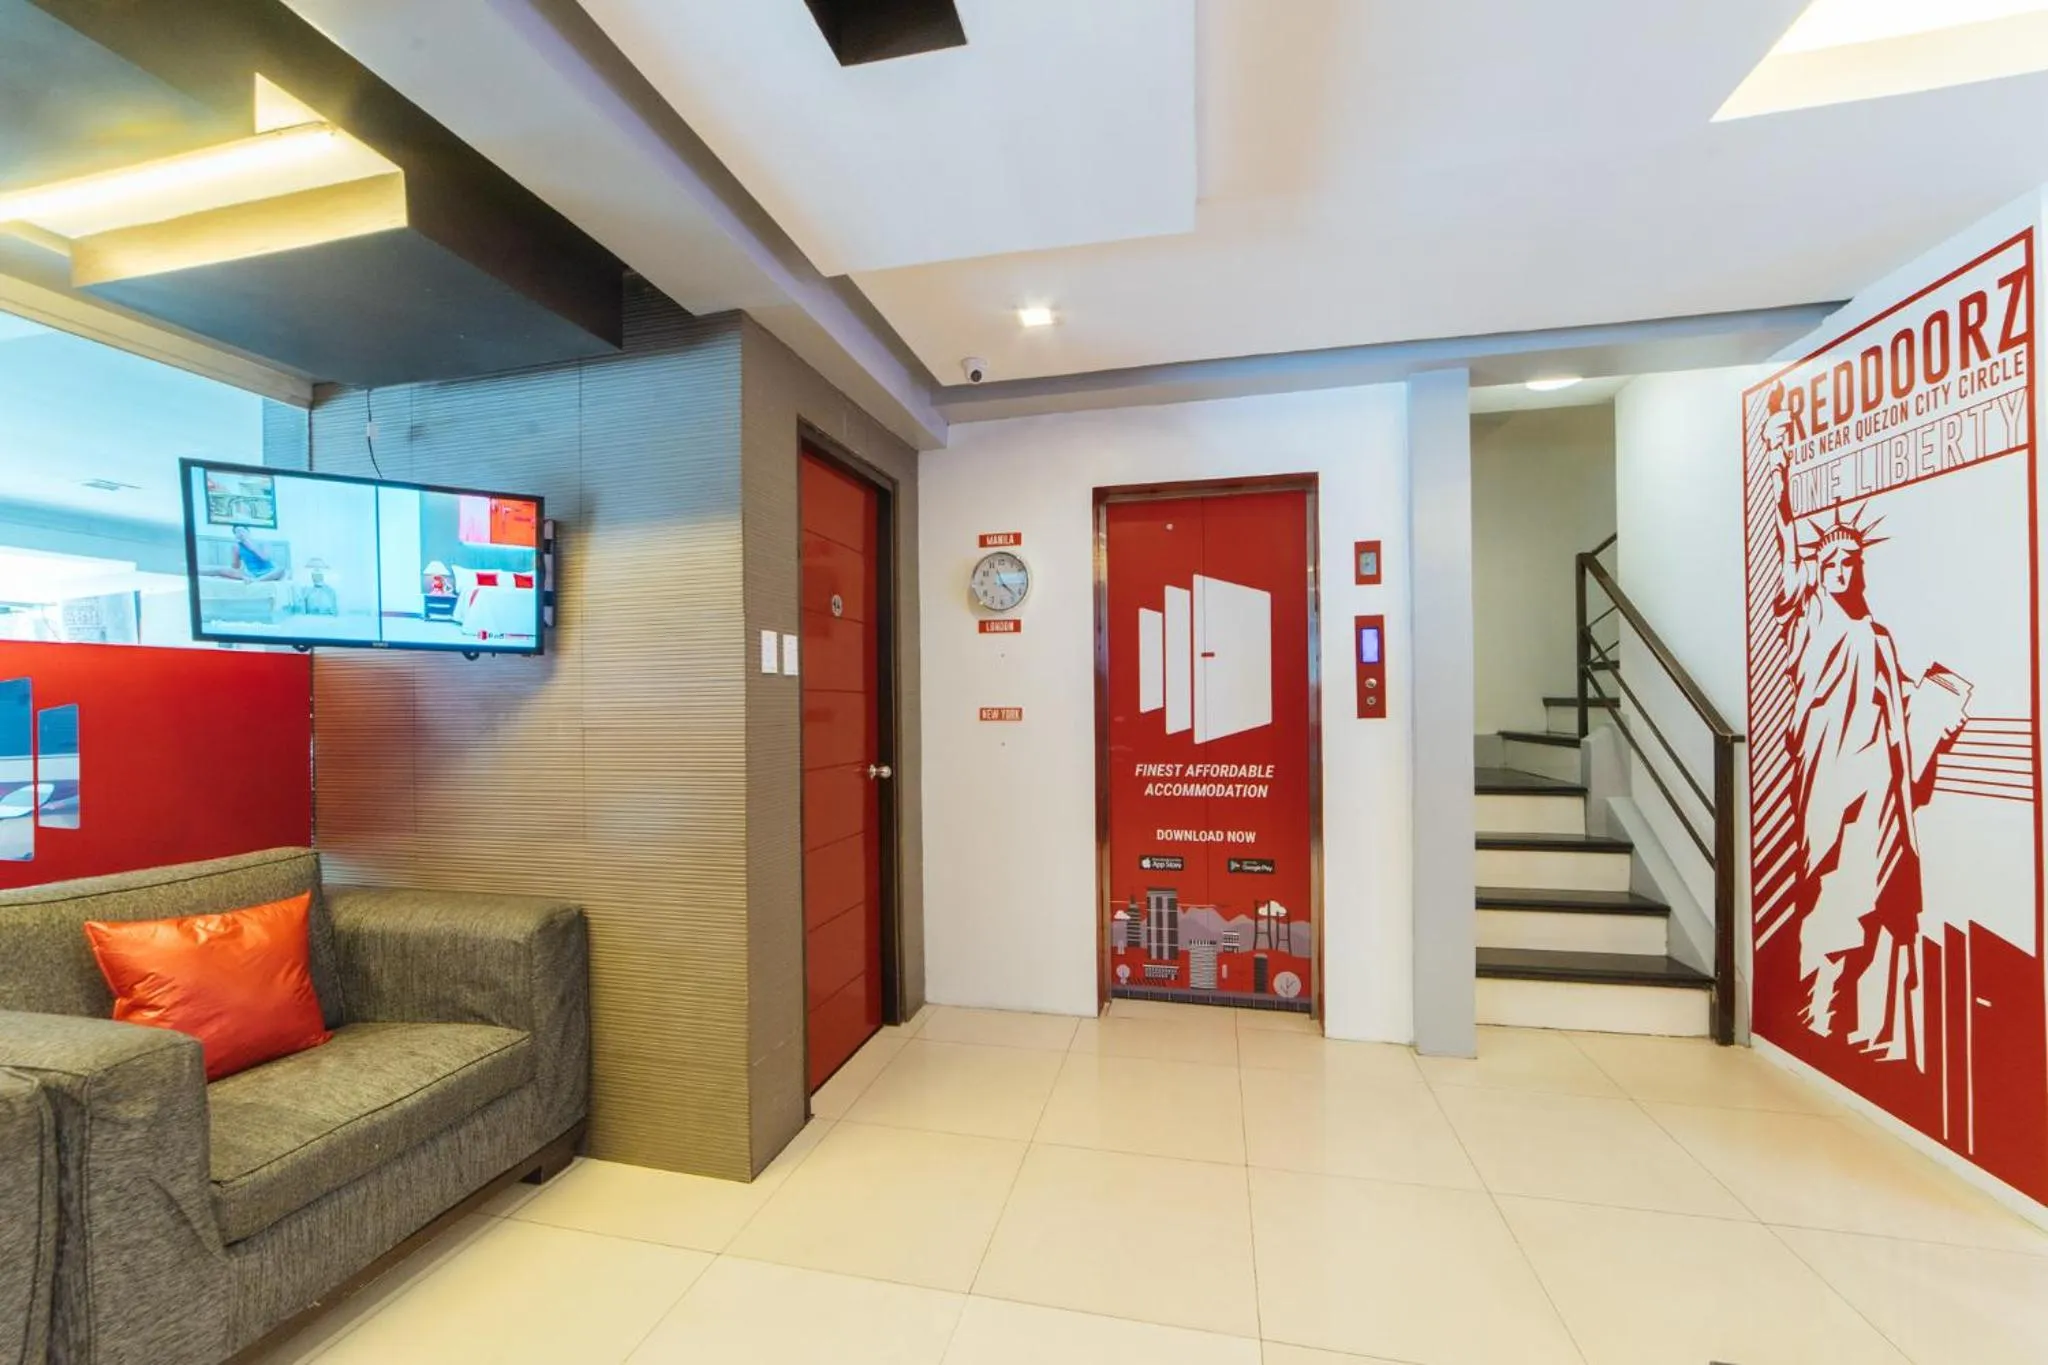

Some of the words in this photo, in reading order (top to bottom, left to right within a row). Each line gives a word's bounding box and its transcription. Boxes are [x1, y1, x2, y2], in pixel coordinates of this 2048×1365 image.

[1787, 265, 2028, 446] REDDOORZ
[1788, 440, 1816, 466] PLUS
[1819, 425, 1851, 456] NEAR
[1855, 403, 1909, 443] QUEZON
[1915, 382, 1952, 418] CITY
[1958, 350, 2025, 399] CIRCLE
[1790, 460, 1842, 515] ONE
[1855, 389, 2026, 498] LIBERTY
[986, 534, 1014, 546] MANILA
[986, 620, 1014, 632] LONDON
[982, 709, 999, 720] NEW
[1001, 709, 1020, 720] YORK
[1135, 764, 1183, 778] FINEST
[1185, 764, 1275, 779] AFFORDABLE
[1144, 783, 1269, 798] ACCOMMODATION
[1156, 829, 1224, 843] DOWNLOAD
[1227, 831, 1256, 844] NOW
